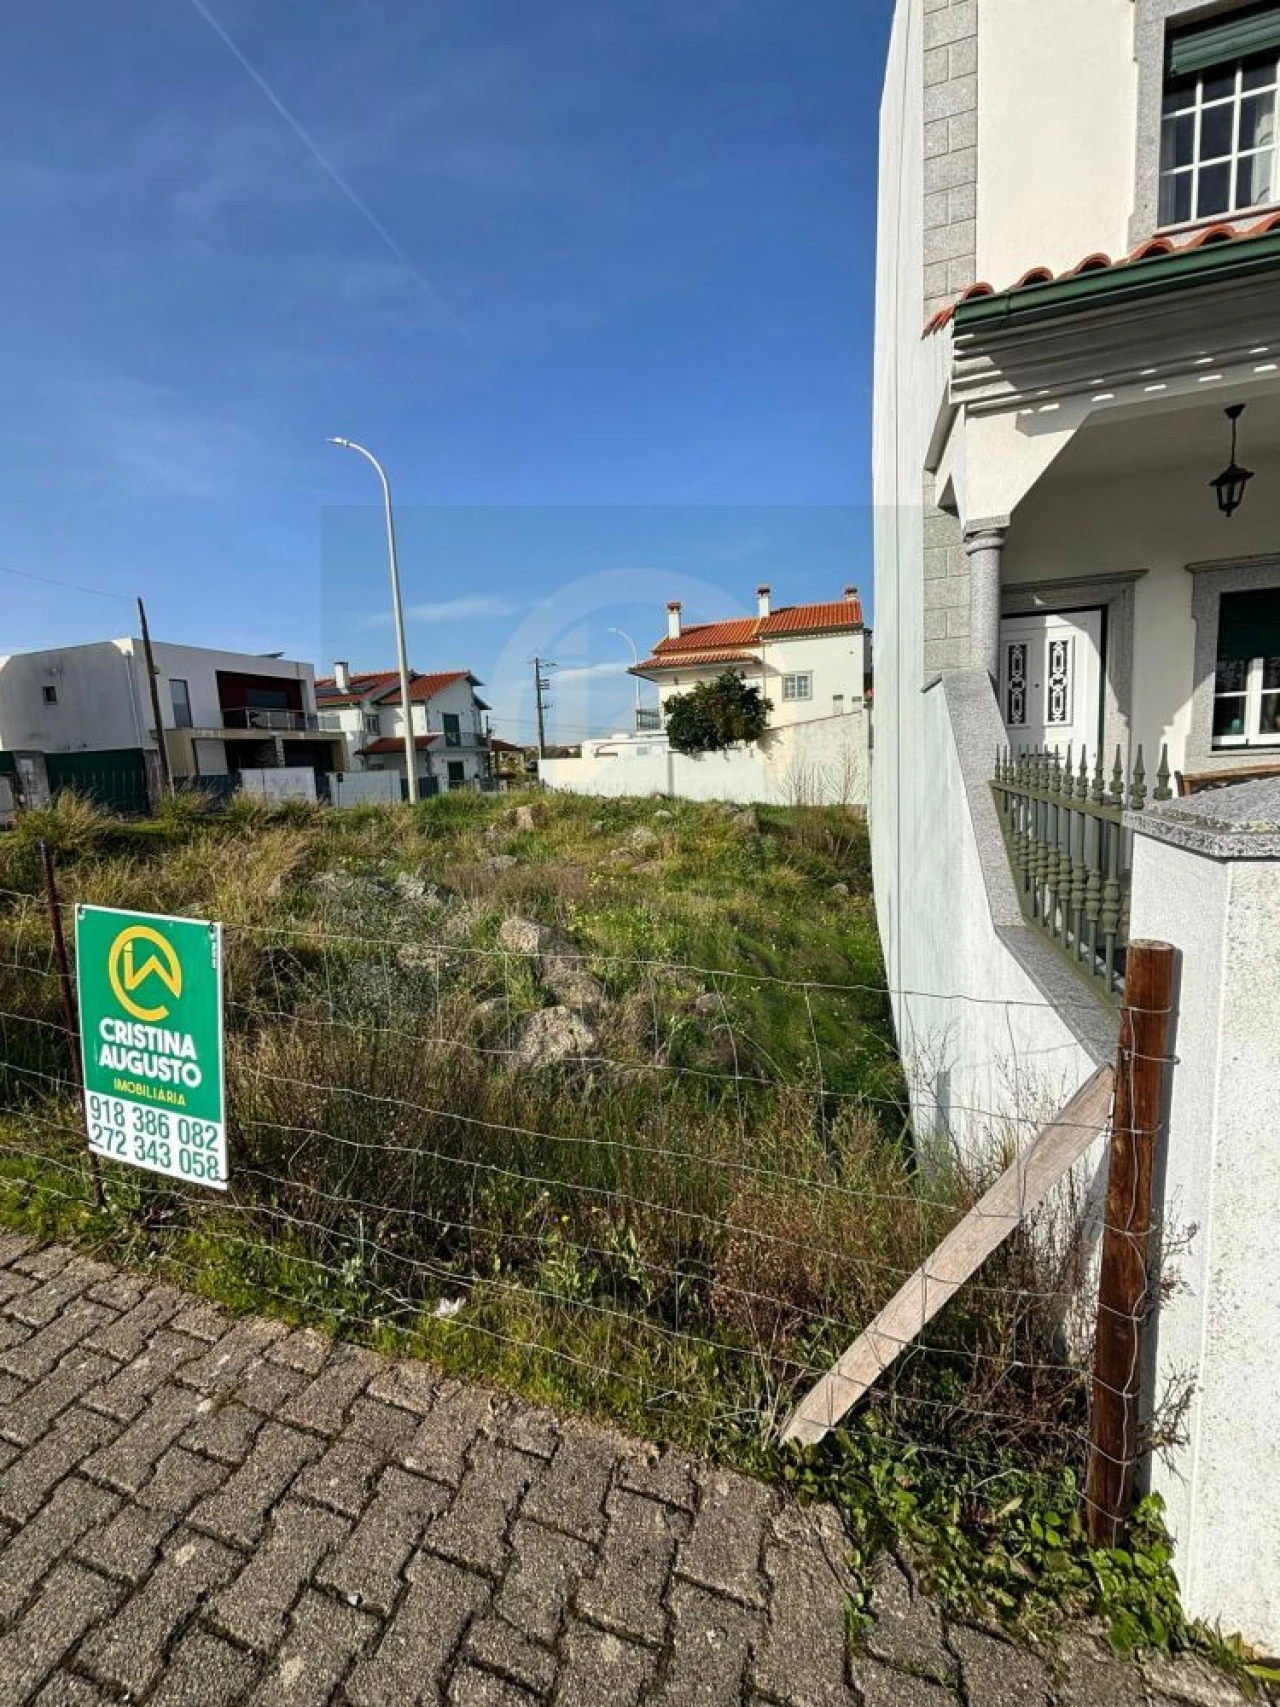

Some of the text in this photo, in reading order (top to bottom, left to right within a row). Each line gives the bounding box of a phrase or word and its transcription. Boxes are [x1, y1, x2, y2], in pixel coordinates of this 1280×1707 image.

[99, 1018, 197, 1060] CRISTINA
[99, 1044, 202, 1087] AUGUSTO
[114, 1078, 186, 1106] IMOBILIÁRIA
[90, 1095, 218, 1152] 918 386 082
[92, 1124, 219, 1182] 272 343 058
